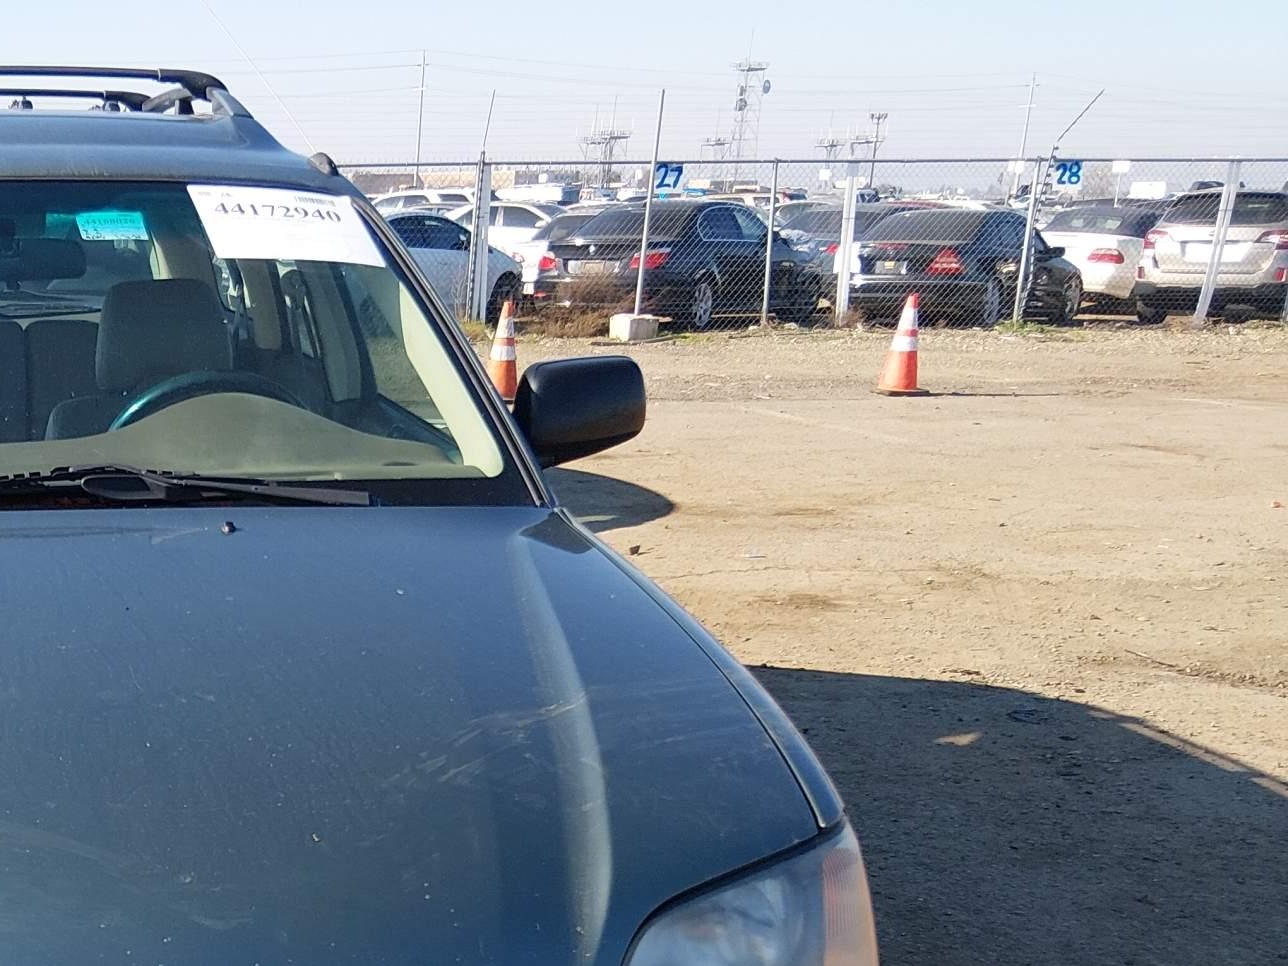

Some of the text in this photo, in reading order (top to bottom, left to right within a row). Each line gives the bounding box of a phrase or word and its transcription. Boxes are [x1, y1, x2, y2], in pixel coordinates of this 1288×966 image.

[656, 163, 683, 189] 27
[1056, 161, 1081, 185] 28
[214, 202, 341, 223] 44172940
